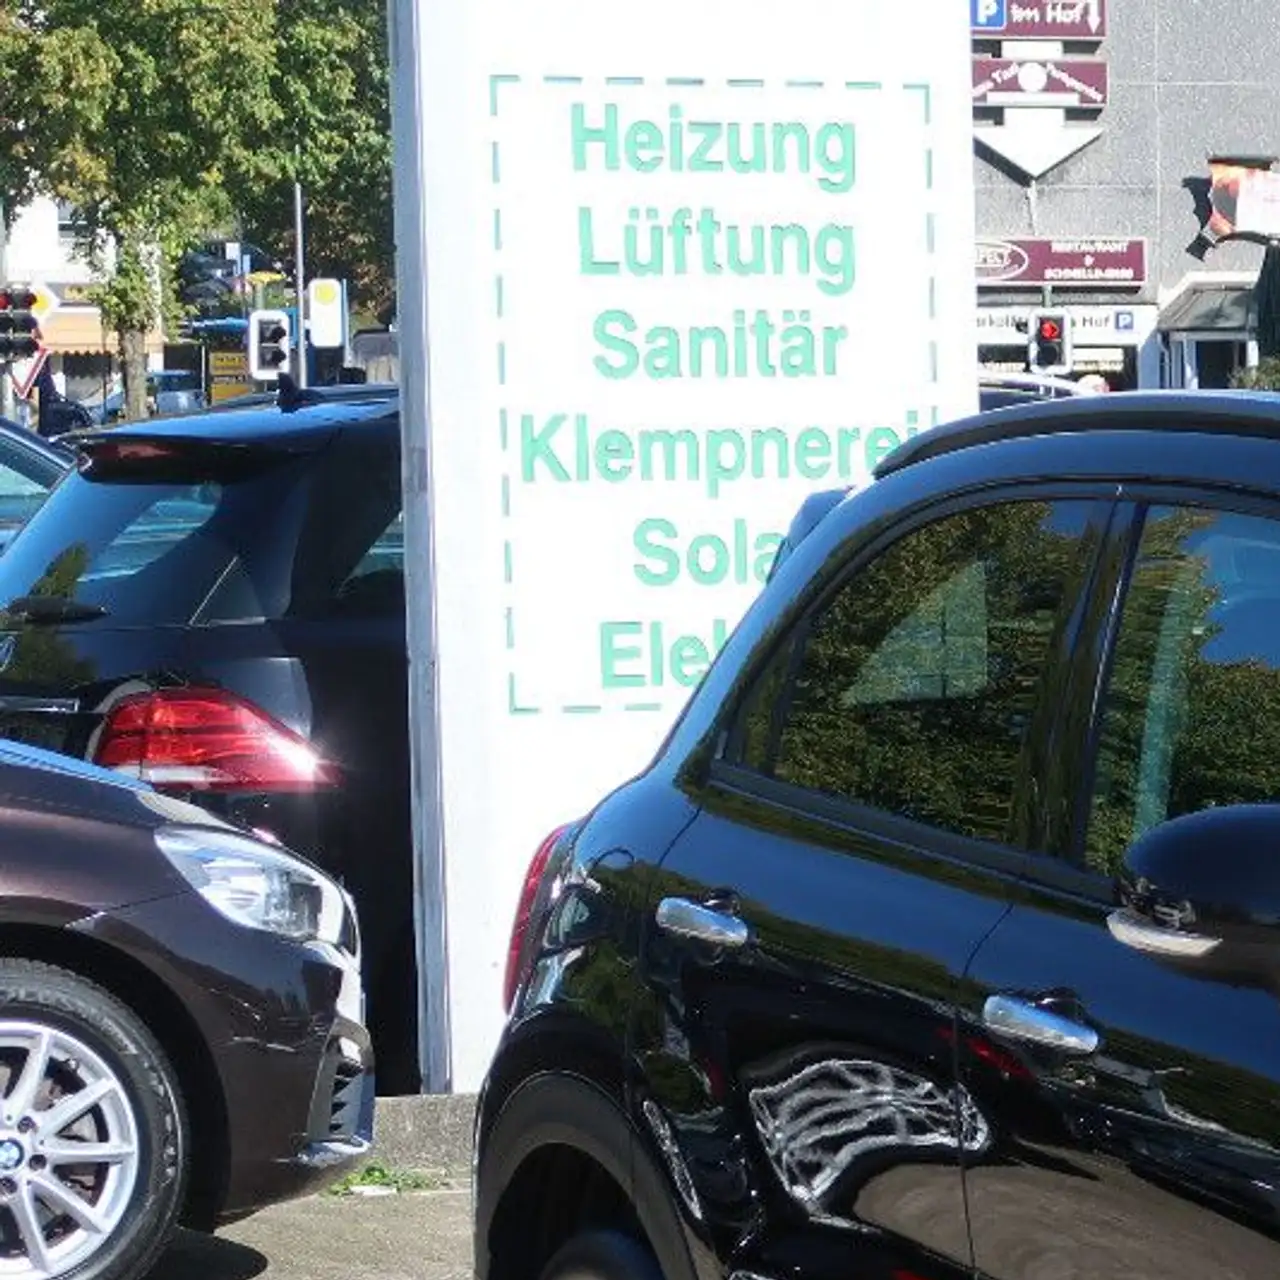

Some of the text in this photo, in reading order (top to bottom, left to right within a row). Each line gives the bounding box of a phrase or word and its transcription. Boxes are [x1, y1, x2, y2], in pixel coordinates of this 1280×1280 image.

[571, 103, 857, 194] Heizung
[578, 206, 857, 296] Lüftung
[593, 307, 848, 380] Sanitär
[633, 517, 788, 587] Sola
